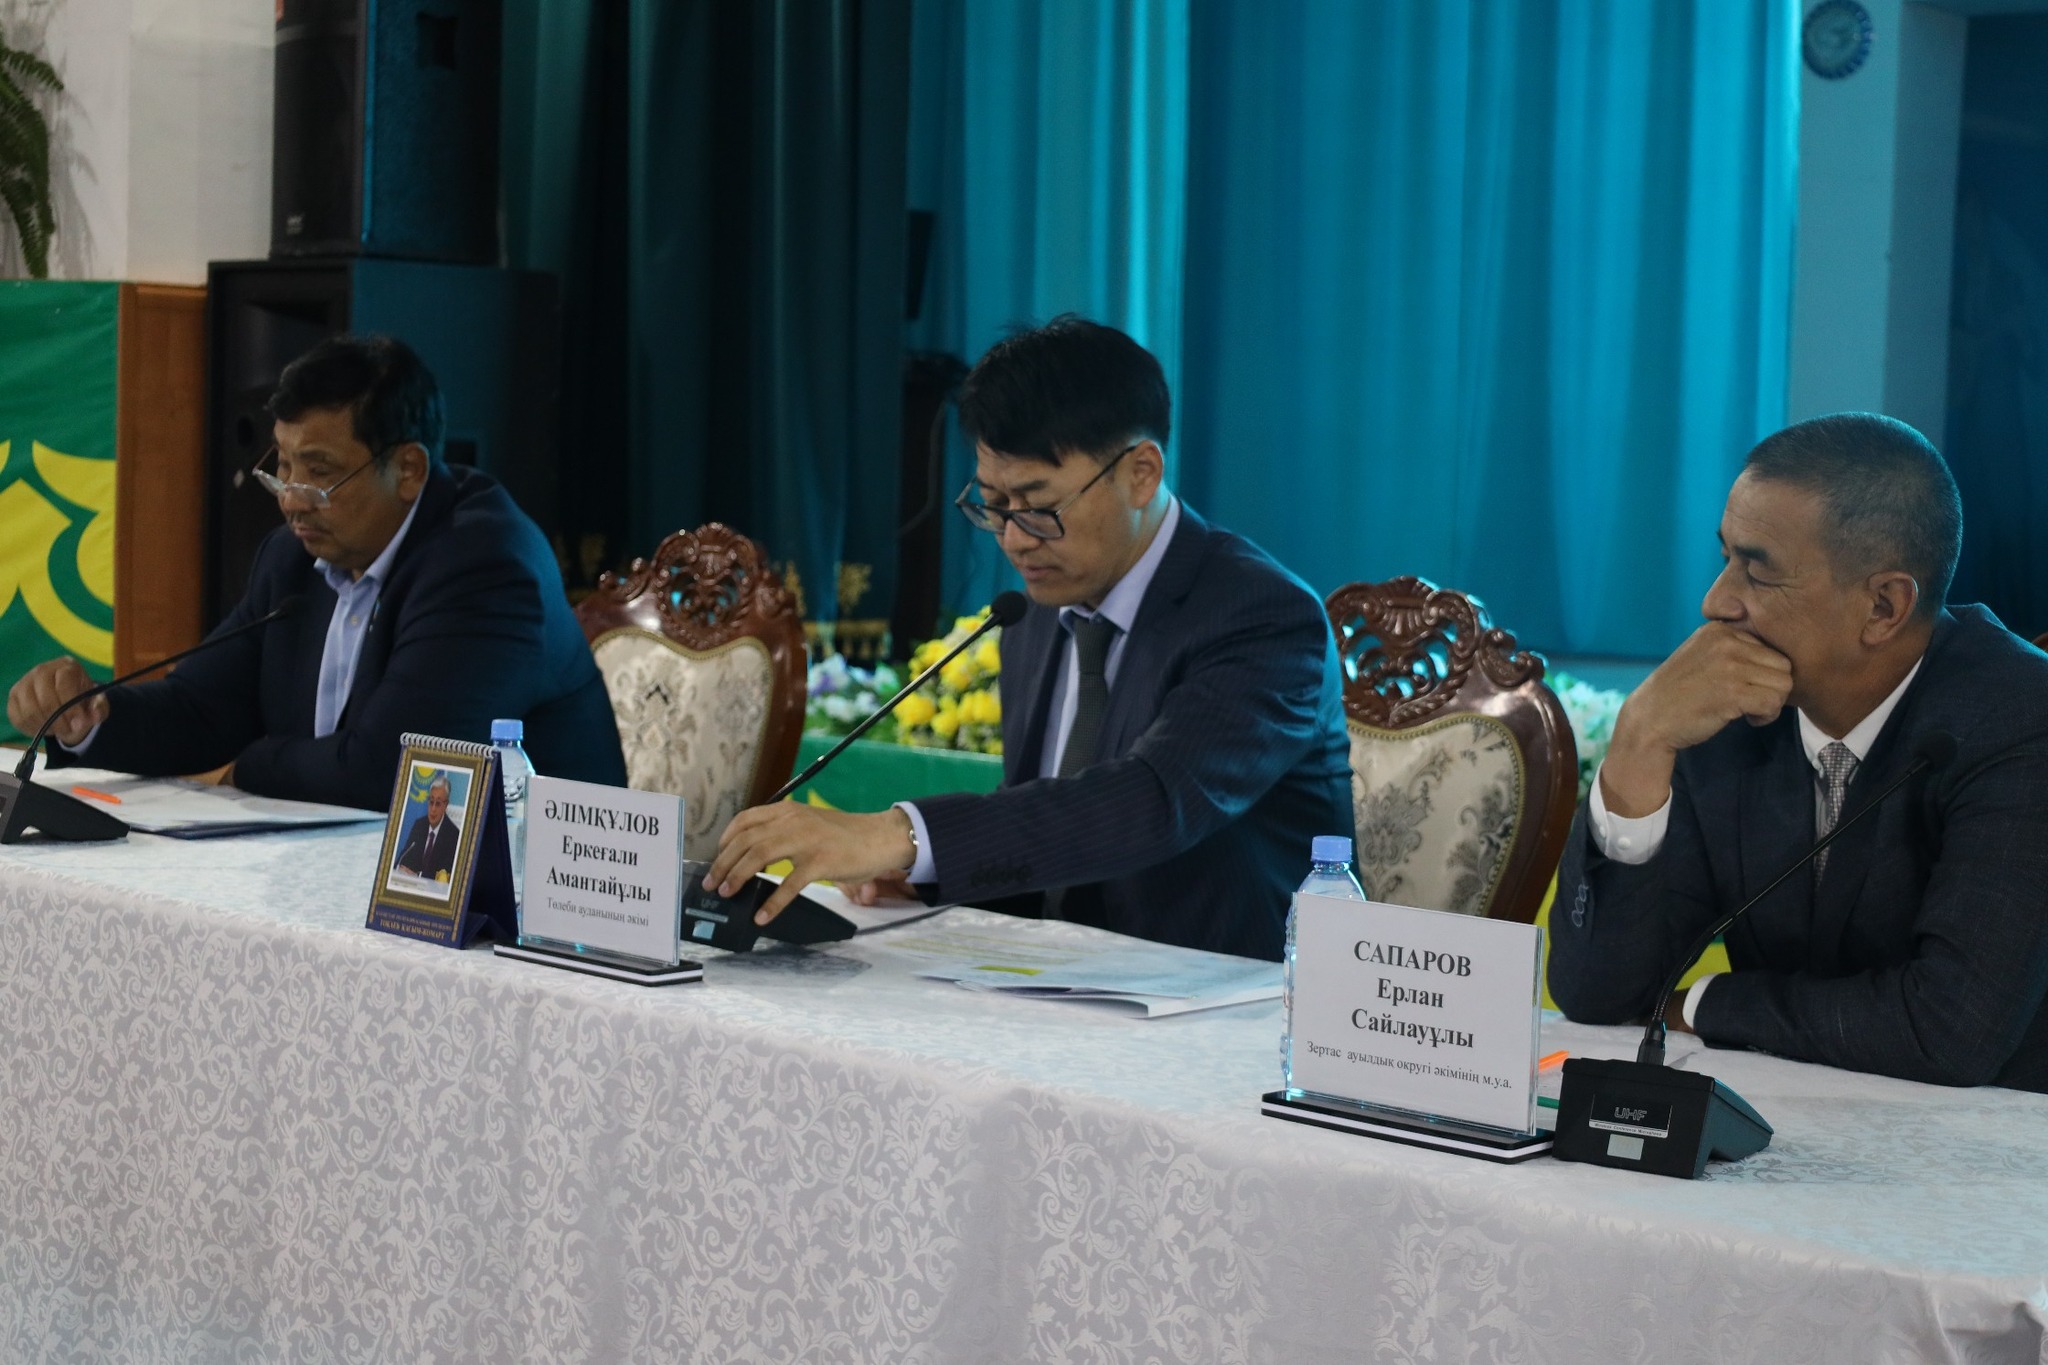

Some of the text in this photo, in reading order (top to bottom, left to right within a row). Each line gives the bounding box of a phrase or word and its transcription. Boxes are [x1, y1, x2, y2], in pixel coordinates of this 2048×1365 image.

[545, 799, 660, 836] ӘЛІМҚҰЛОВ
[562, 834, 638, 867] Еркеғали
[546, 865, 651, 903] Амантайұлы
[1353, 939, 1472, 977] САПАРОВ
[1376, 976, 1443, 1009] Ерлан
[1351, 1007, 1474, 1049] Сайлауұлы
[1307, 1040, 1341, 1058] Зертас
[1396, 1060, 1431, 1076] округі
[1433, 1065, 1480, 1084] әкімінің
[1482, 1074, 1512, 1089] м.у.а.
[1614, 1106, 1648, 1122] UHF
